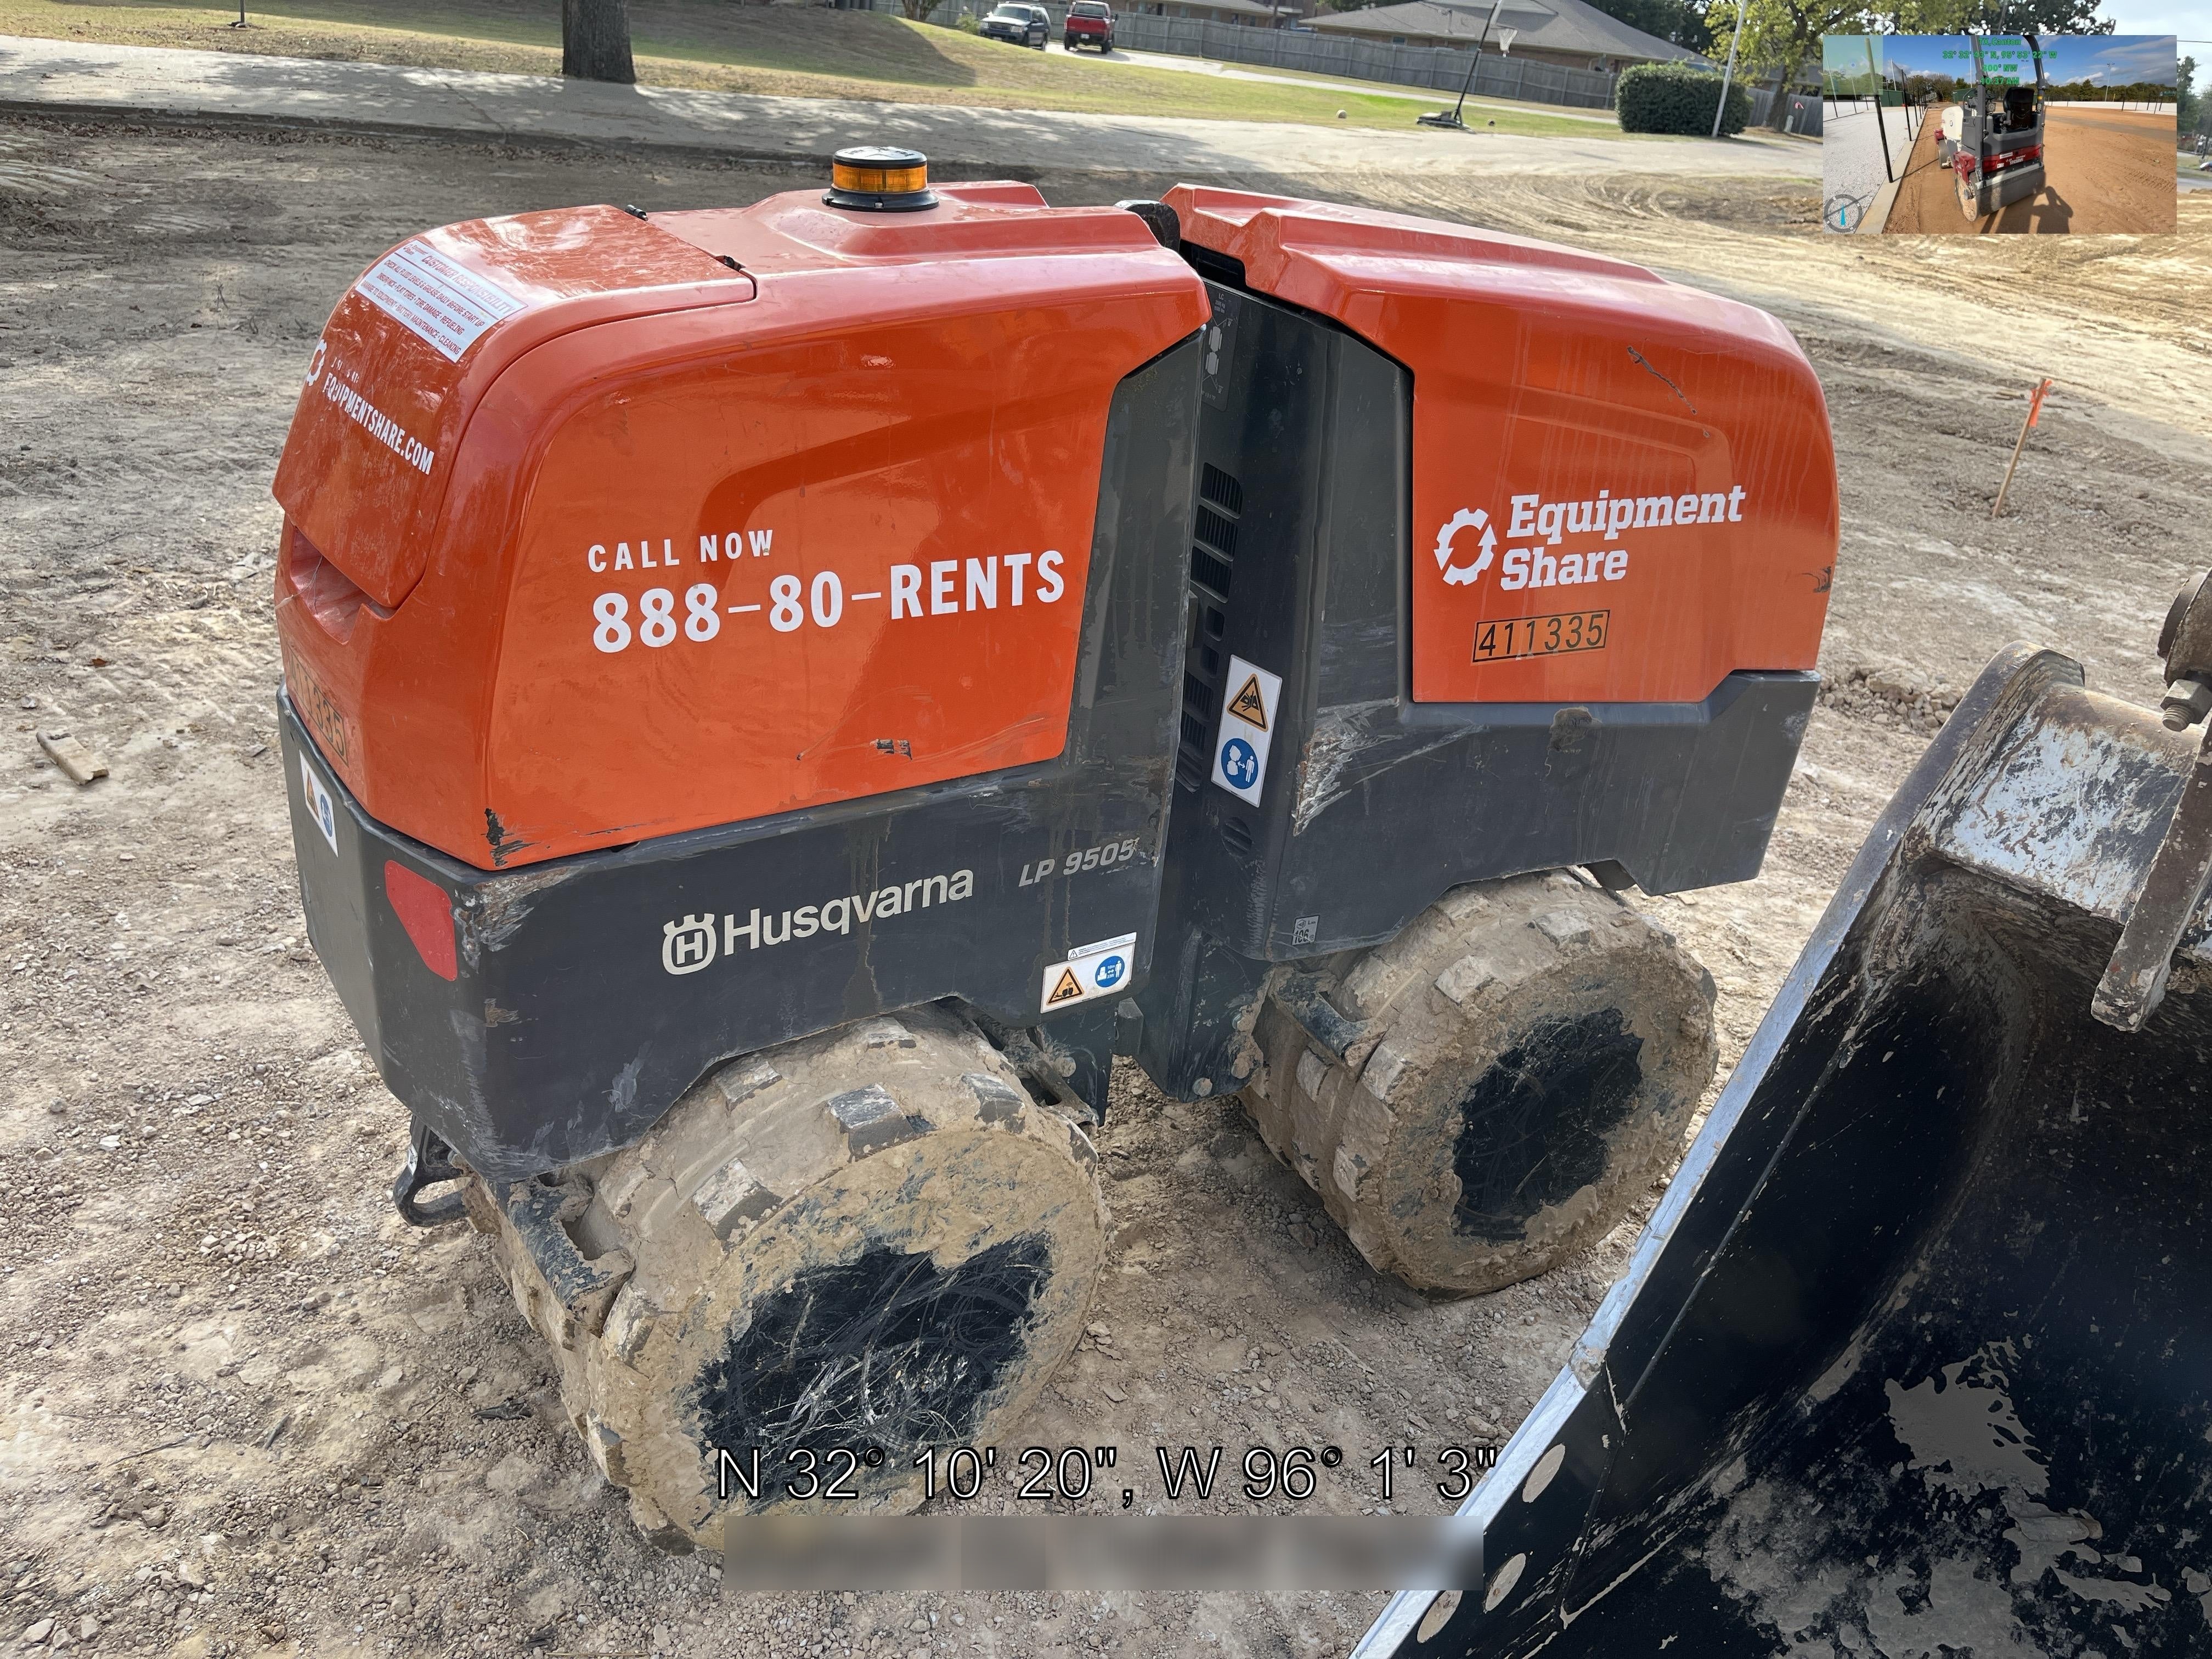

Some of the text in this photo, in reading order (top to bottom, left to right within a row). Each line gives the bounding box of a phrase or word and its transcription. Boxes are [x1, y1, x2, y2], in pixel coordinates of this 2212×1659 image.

[421, 255, 460, 278] CUSTOMER
[413, 297, 427, 308] TIRE
[421, 303, 443, 319] DAMAGE
[438, 315, 466, 335] REFUELING
[435, 293, 452, 304] DAILY
[445, 300, 466, 315] BEFORE
[460, 311, 479, 324] START
[473, 319, 486, 328] UP
[409, 315, 441, 338] MAINTENANCE
[436, 335, 463, 354] CLEANING
[1506, 485, 1746, 545] Equipment
[588, 529, 773, 573] CALL NOW
[1500, 547, 1628, 591] Share
[1479, 614, 1604, 657] 411335
[1018, 838, 1136, 887] LP 9505
[724, 869, 974, 956] Husqvarna
